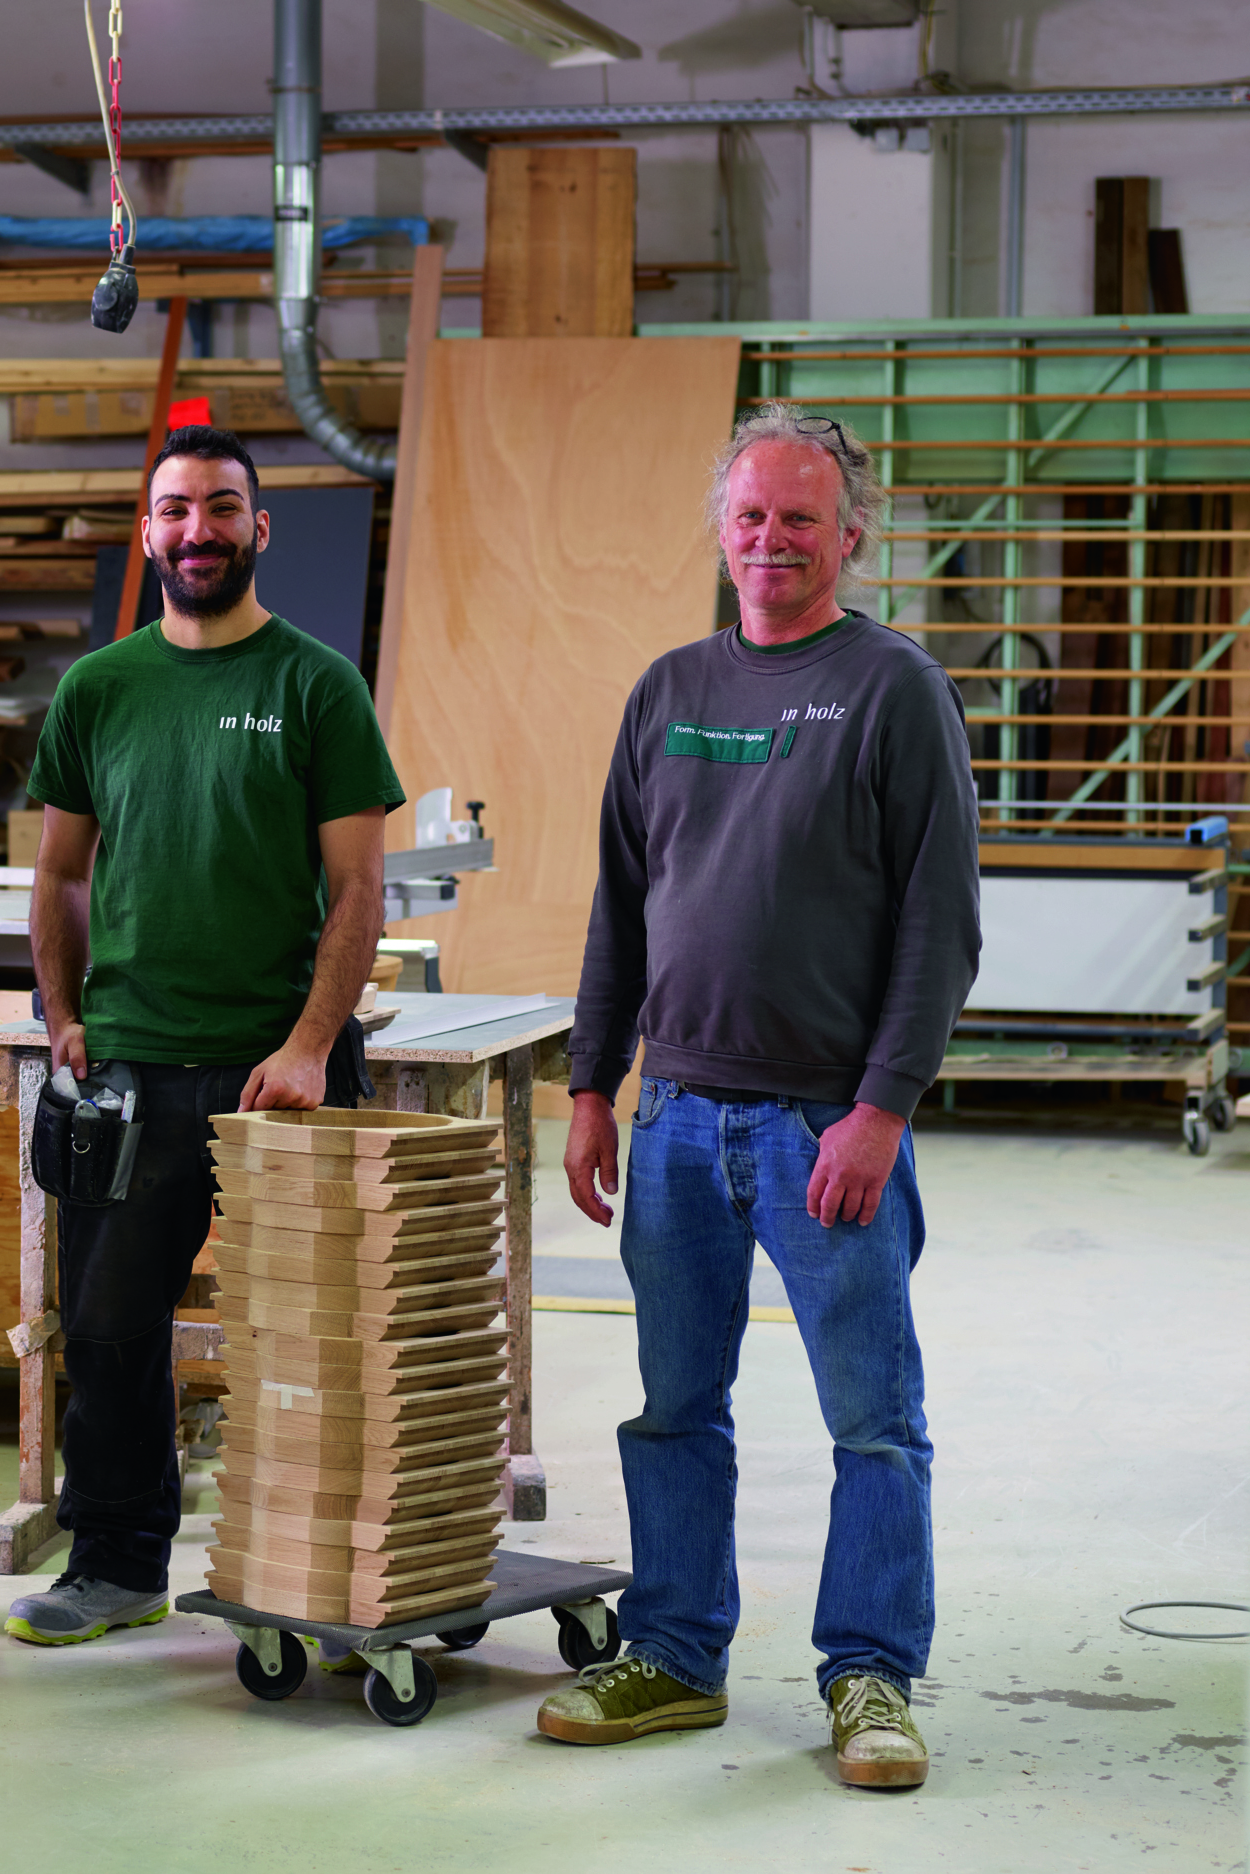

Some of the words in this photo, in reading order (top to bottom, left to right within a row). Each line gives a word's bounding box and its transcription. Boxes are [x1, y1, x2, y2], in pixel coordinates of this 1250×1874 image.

[804, 702, 846, 719] holz
[244, 712, 283, 732] holz
[674, 725, 696, 734] Form.
